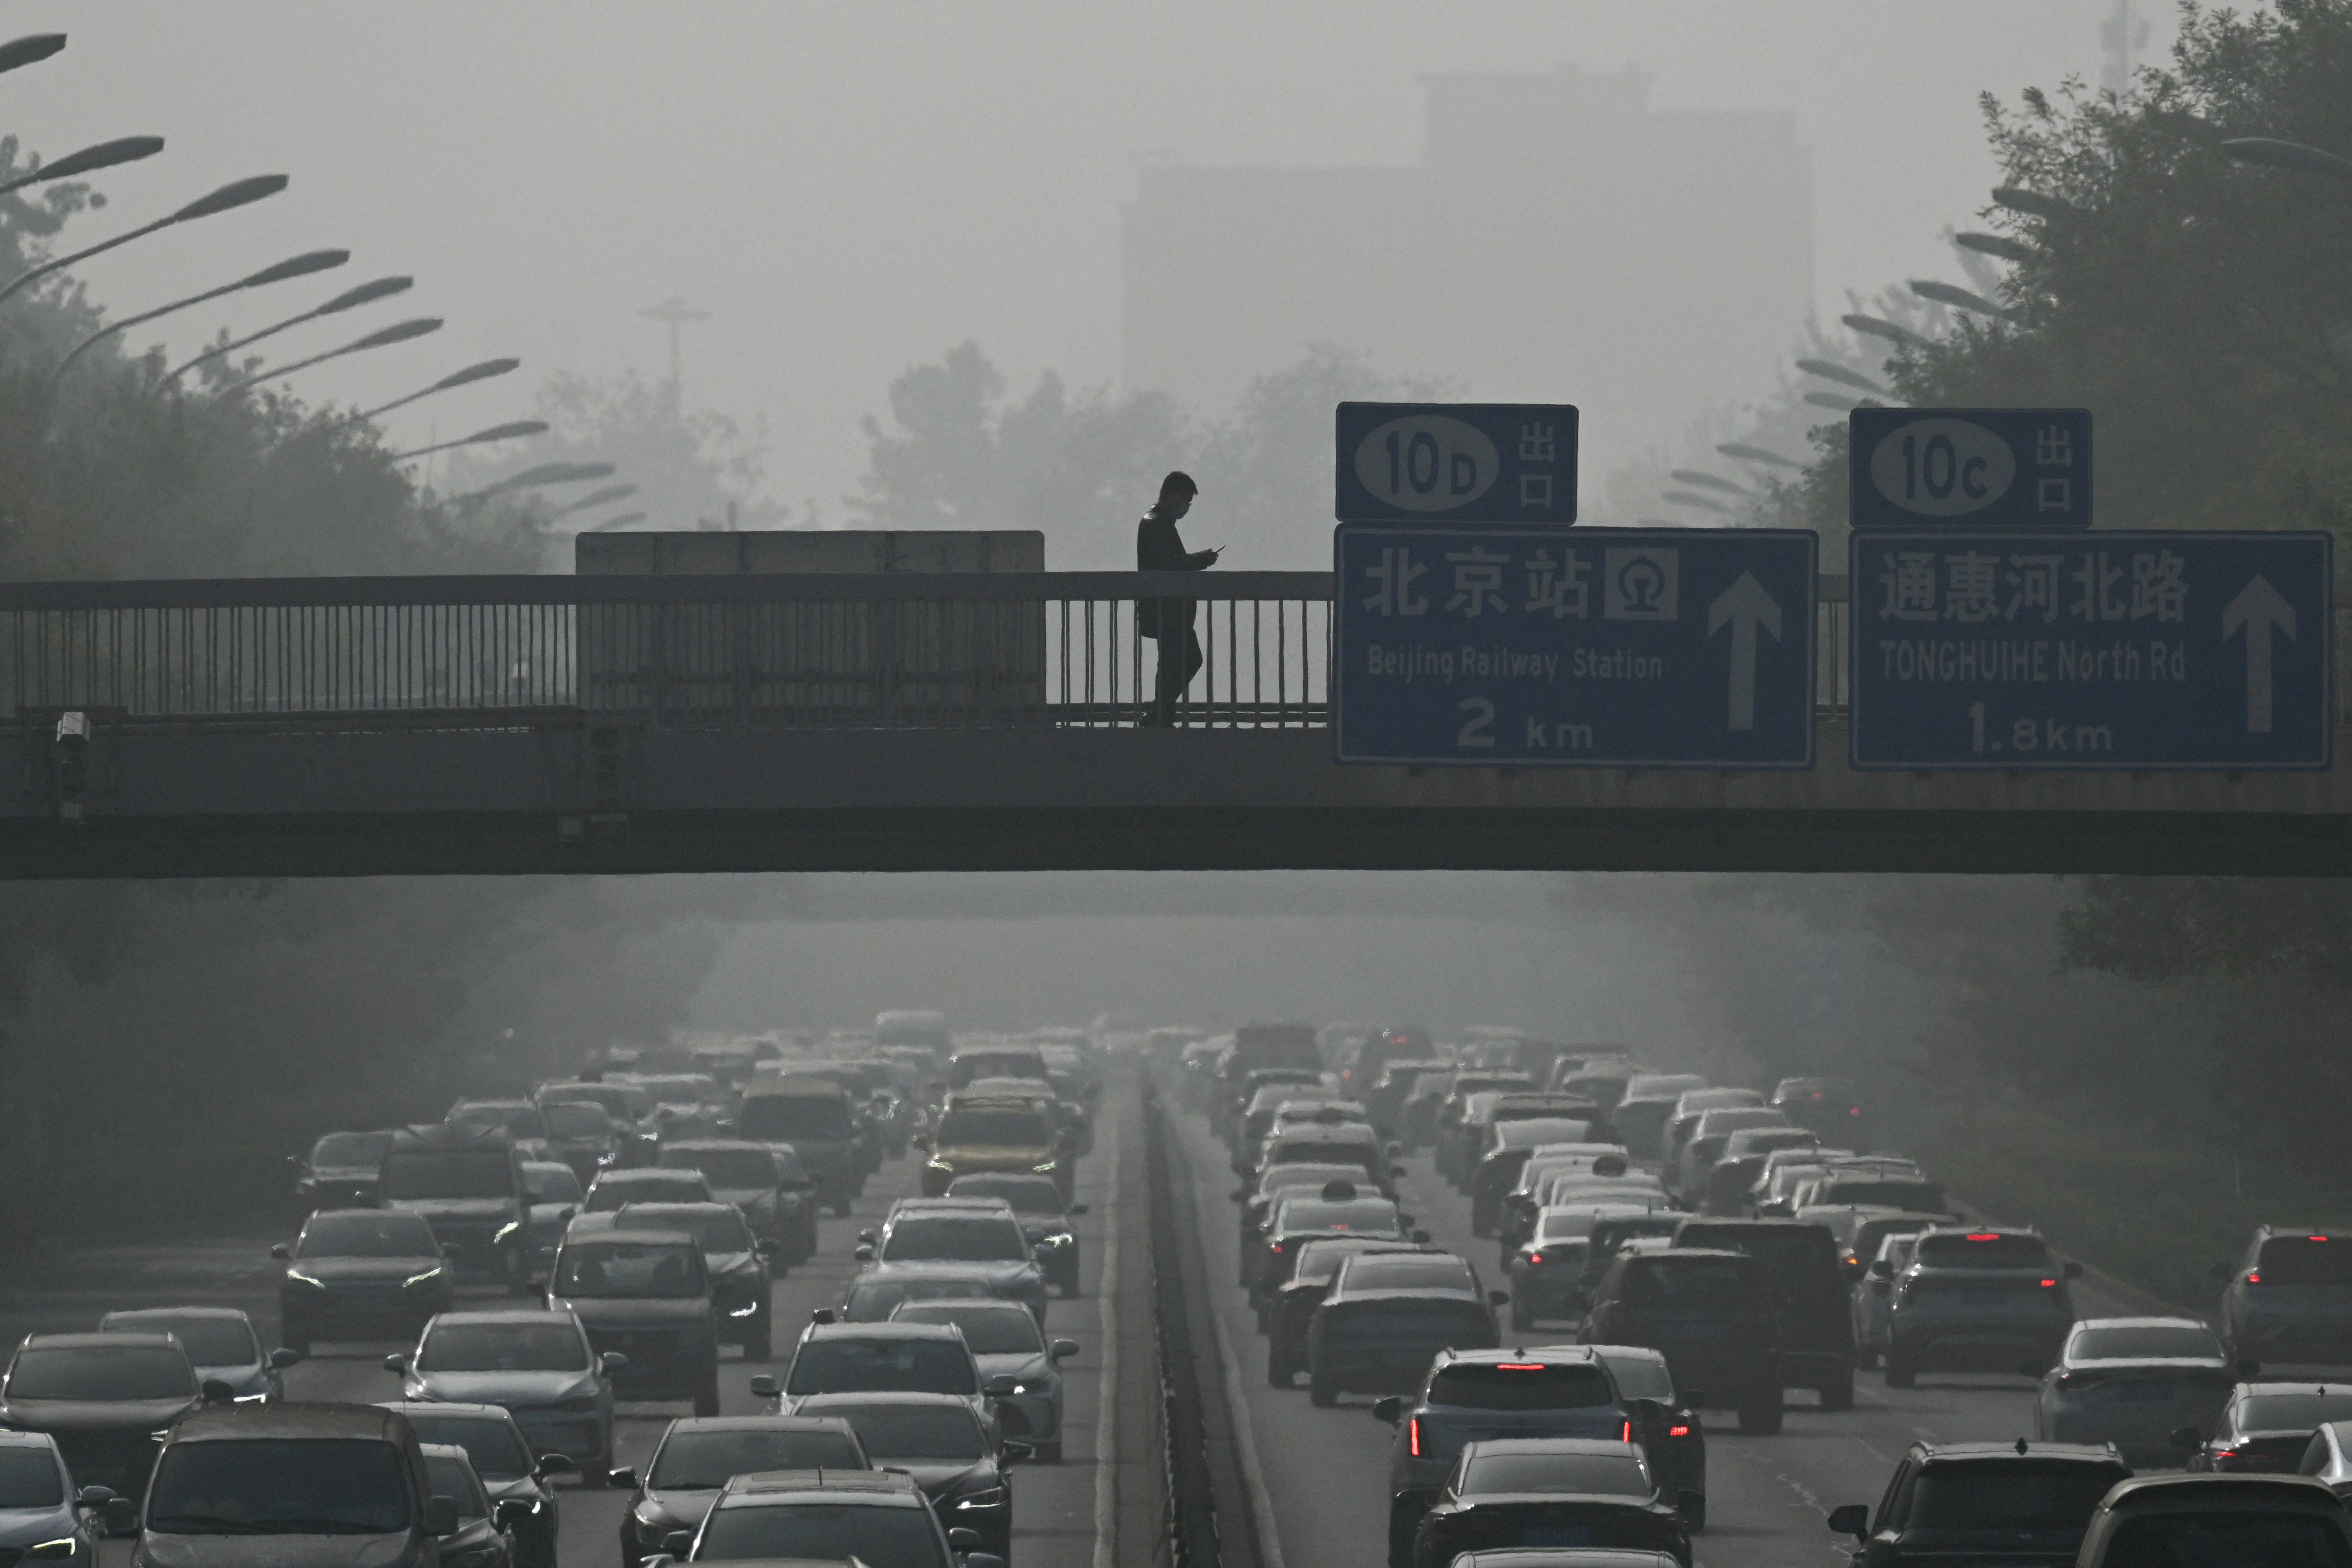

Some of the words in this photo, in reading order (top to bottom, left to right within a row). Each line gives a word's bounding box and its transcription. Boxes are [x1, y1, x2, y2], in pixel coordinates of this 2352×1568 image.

[1386, 431, 1476, 496] 10D
[1519, 423, 1555, 507] 出口
[2036, 425, 2072, 511] 出口
[1364, 546, 1591, 619] 北京站
[1879, 550, 2187, 622] 通惠河北路
[1369, 645, 1453, 683] Beijing
[1462, 645, 1558, 682] Railway
[1573, 648, 1662, 678] Station
[1880, 639, 2047, 680] TONGHUIHE
[2058, 641, 2139, 681] North
[2150, 640, 2185, 680] Rd
[1458, 697, 1495, 747] 2
[1527, 716, 1592, 748] km
